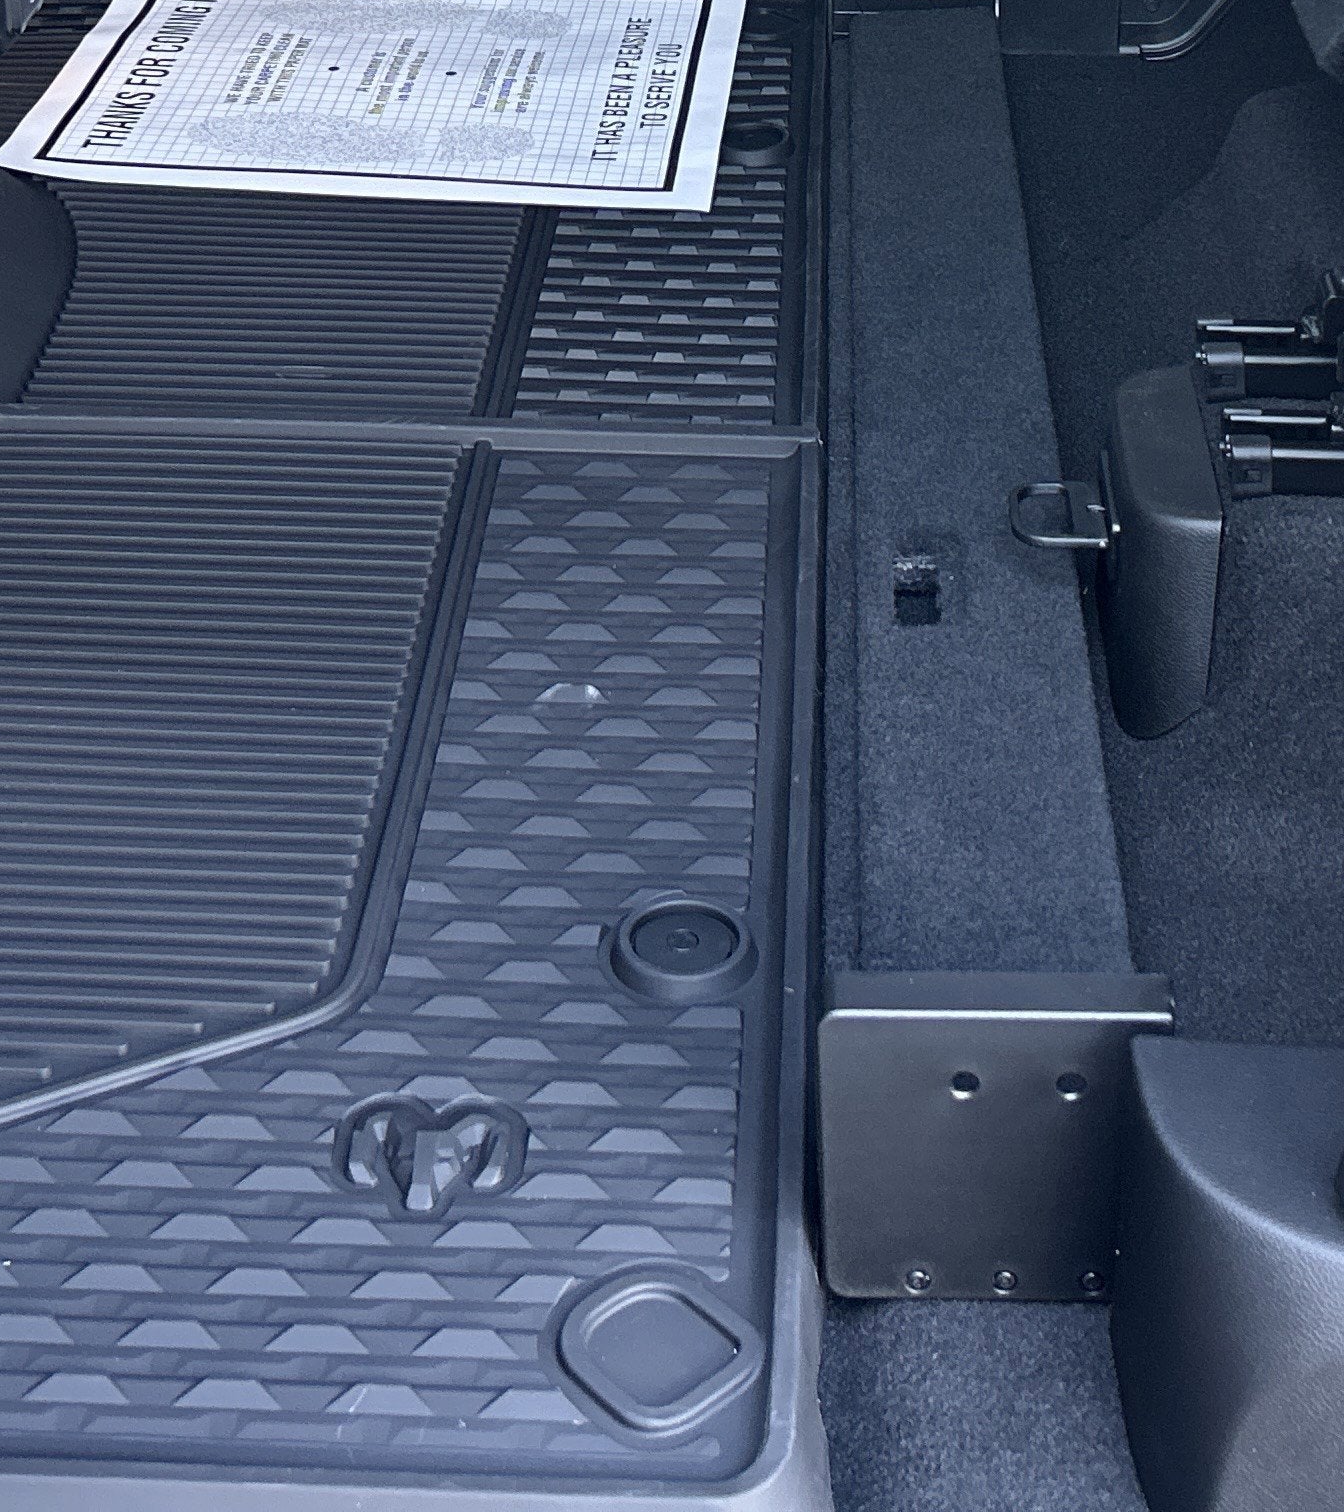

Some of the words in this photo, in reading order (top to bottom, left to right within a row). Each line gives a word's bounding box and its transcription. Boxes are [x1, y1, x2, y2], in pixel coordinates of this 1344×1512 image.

[146, 5, 213, 53] COMING
[614, 17, 652, 69] PLEASURE
[654, 43, 683, 65] YOU
[125, 58, 178, 87] FOR
[612, 73, 637, 82] A
[602, 84, 634, 116] BEEN
[644, 69, 677, 109] SERVE
[82, 92, 156, 148] THANKS
[594, 120, 626, 145] HAS
[640, 113, 668, 129] TO
[591, 149, 618, 161] IT
